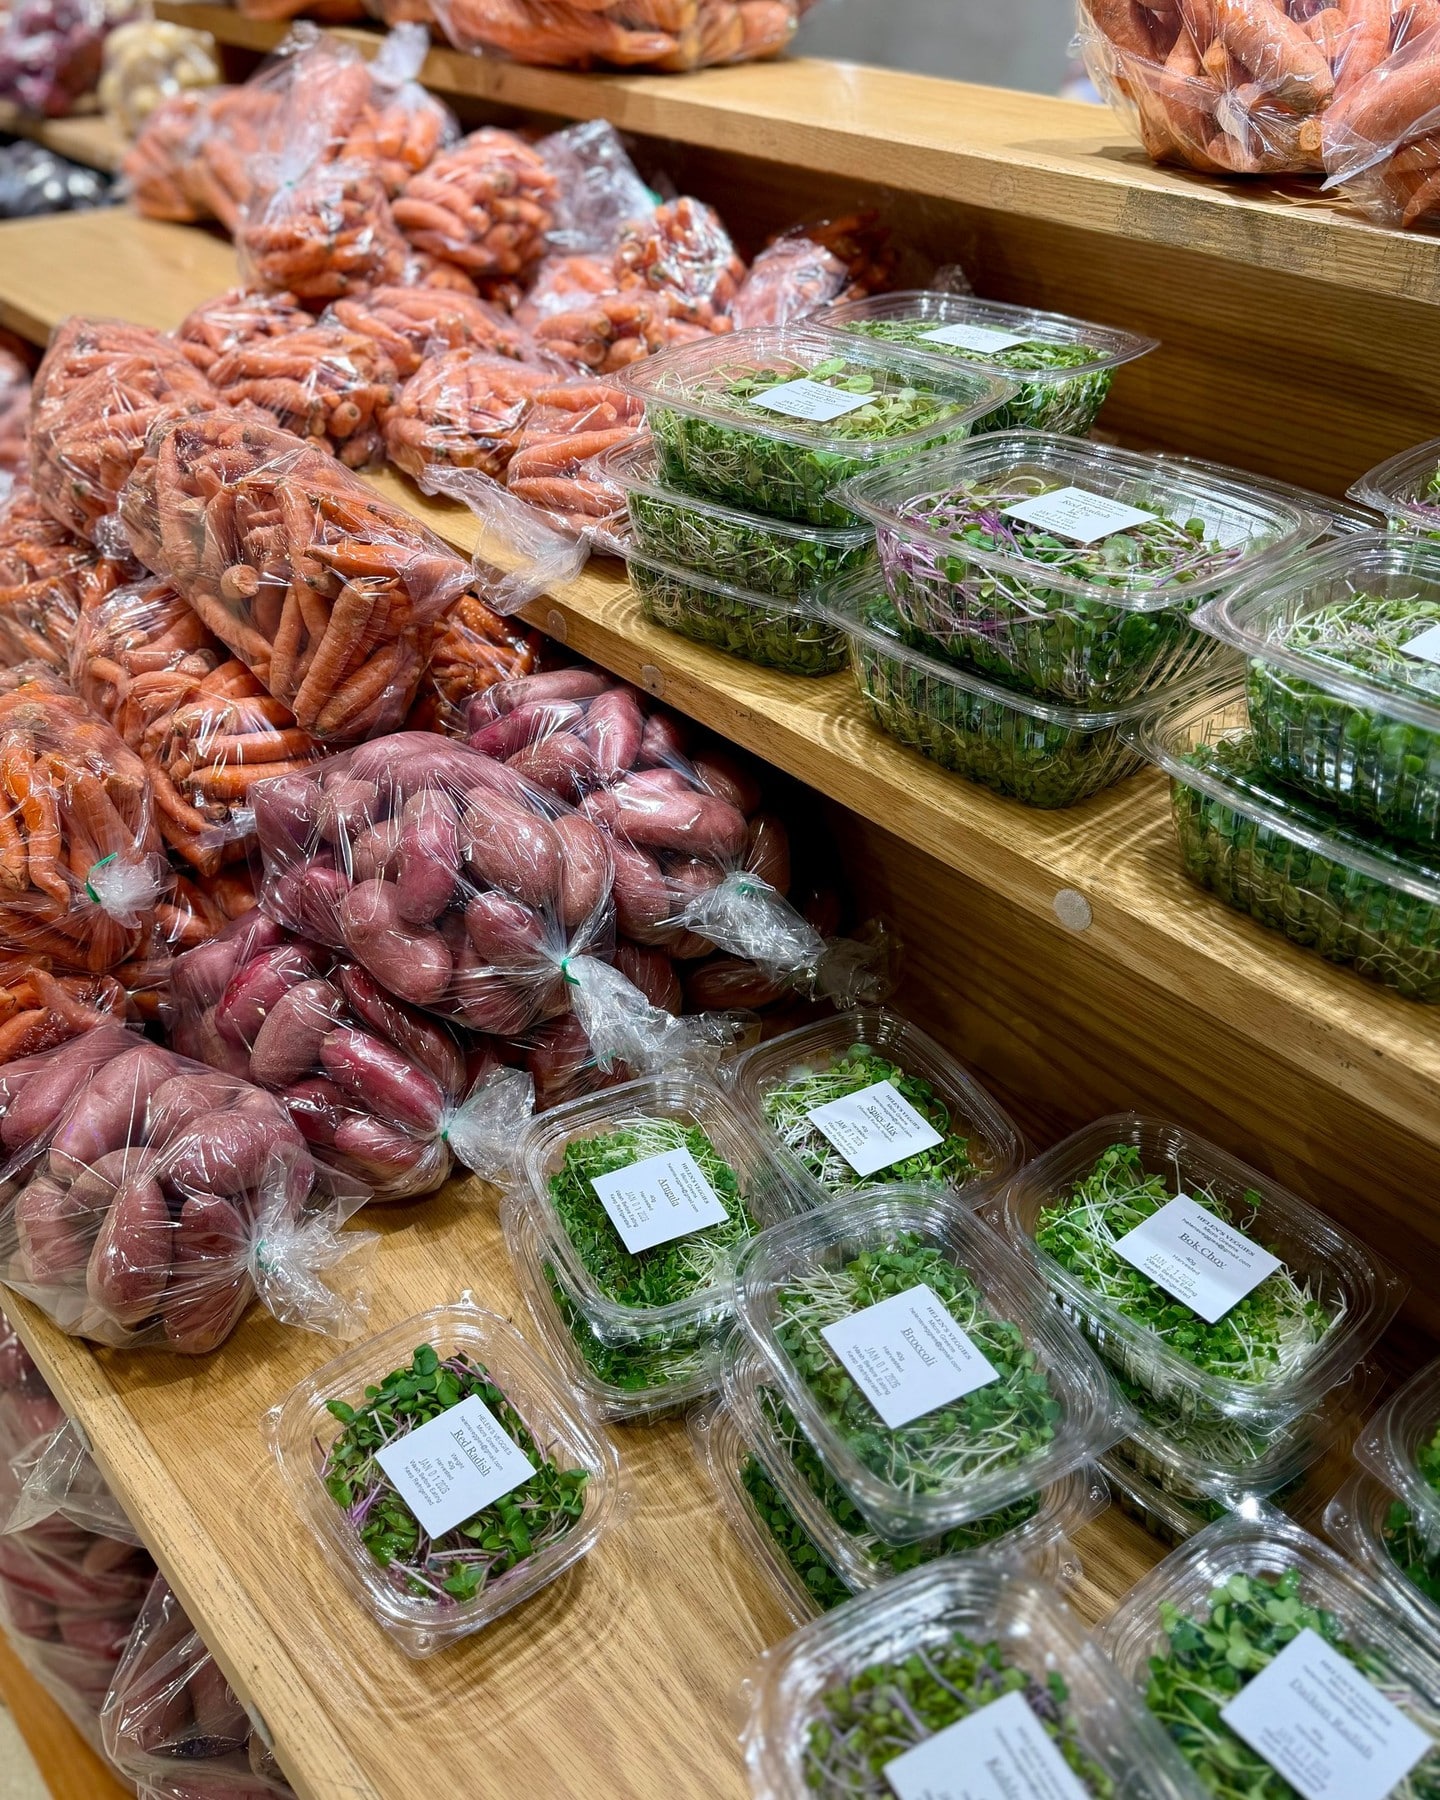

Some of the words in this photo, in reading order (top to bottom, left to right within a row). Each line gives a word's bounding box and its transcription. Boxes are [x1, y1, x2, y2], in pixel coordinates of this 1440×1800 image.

[865, 1105, 888, 1124] Spicy
[881, 1121, 900, 1136] Mix
[656, 1176, 683, 1207] Arugula
[1177, 1231, 1203, 1251] Bok
[1196, 1246, 1229, 1270] Choy
[1195, 1214, 1227, 1236] HELEN'S
[1224, 1234, 1256, 1257] VEGGIES
[1202, 1225, 1220, 1238] Micro
[1217, 1236, 1240, 1252] Greens
[1149, 1252, 1168, 1266] JAN
[1171, 1254, 1200, 1275] Harvested
[899, 1326, 938, 1367] Broccoli
[925, 1306, 950, 1333] HELEN'S
[946, 1331, 973, 1360] VEGGIES
[927, 1319, 942, 1334] Micro
[938, 1333, 957, 1353] Greens
[851, 1344, 866, 1361] Wash
[862, 1359, 879, 1378] Before
[874, 1376, 892, 1396] Eating
[864, 1346, 881, 1361] JAN
[880, 1345, 905, 1373] Harvested
[854, 1363, 882, 1397] Refrigerated
[477, 1413, 497, 1436] HELEN'S
[492, 1433, 512, 1456] VEGGIES
[417, 1456, 434, 1472] JAN
[451, 1427, 472, 1448] Red
[464, 1445, 493, 1477] Radish
